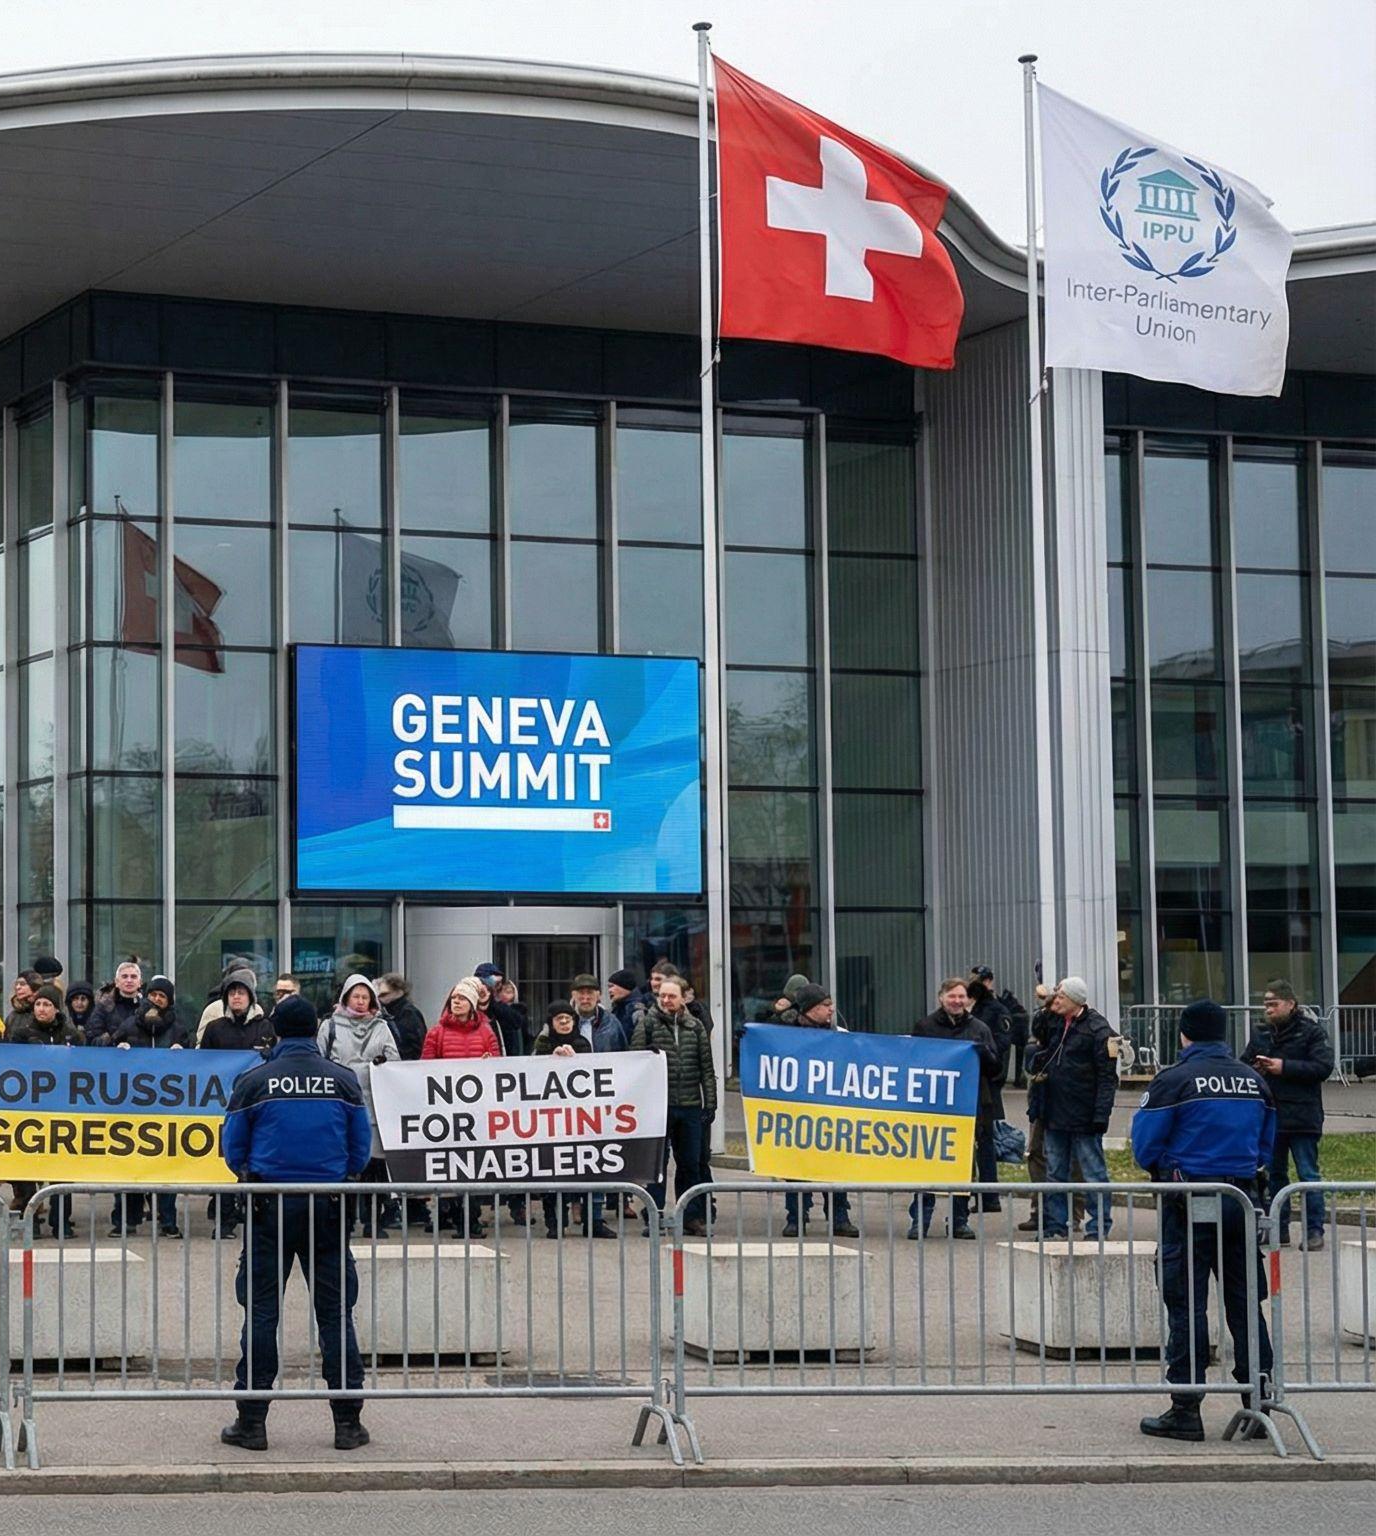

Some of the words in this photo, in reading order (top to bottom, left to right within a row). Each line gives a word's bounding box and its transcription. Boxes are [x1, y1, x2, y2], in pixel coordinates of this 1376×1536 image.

[1143, 221, 1194, 243] IPPU
[1067, 278, 1272, 330] Inter-Parliamentary
[1136, 315, 1196, 344] Union
[392, 693, 611, 747] GENEVA
[392, 749, 611, 801] SUMMIT
[69, 1072, 229, 1108] RUSSIA
[268, 1077, 336, 1094] POLIZE
[426, 1074, 484, 1106] NO
[494, 1068, 616, 1102] PLACE
[758, 1054, 799, 1093] NO
[807, 1059, 899, 1101] PLACE
[907, 1067, 961, 1106] ETT
[1195, 1076, 1260, 1095] POLIZE
[400, 1112, 477, 1144] FOR
[487, 1104, 638, 1141] PUTIN'S
[756, 1110, 957, 1162] PROGRESSIVE
[425, 1143, 625, 1182] ENABLERS
